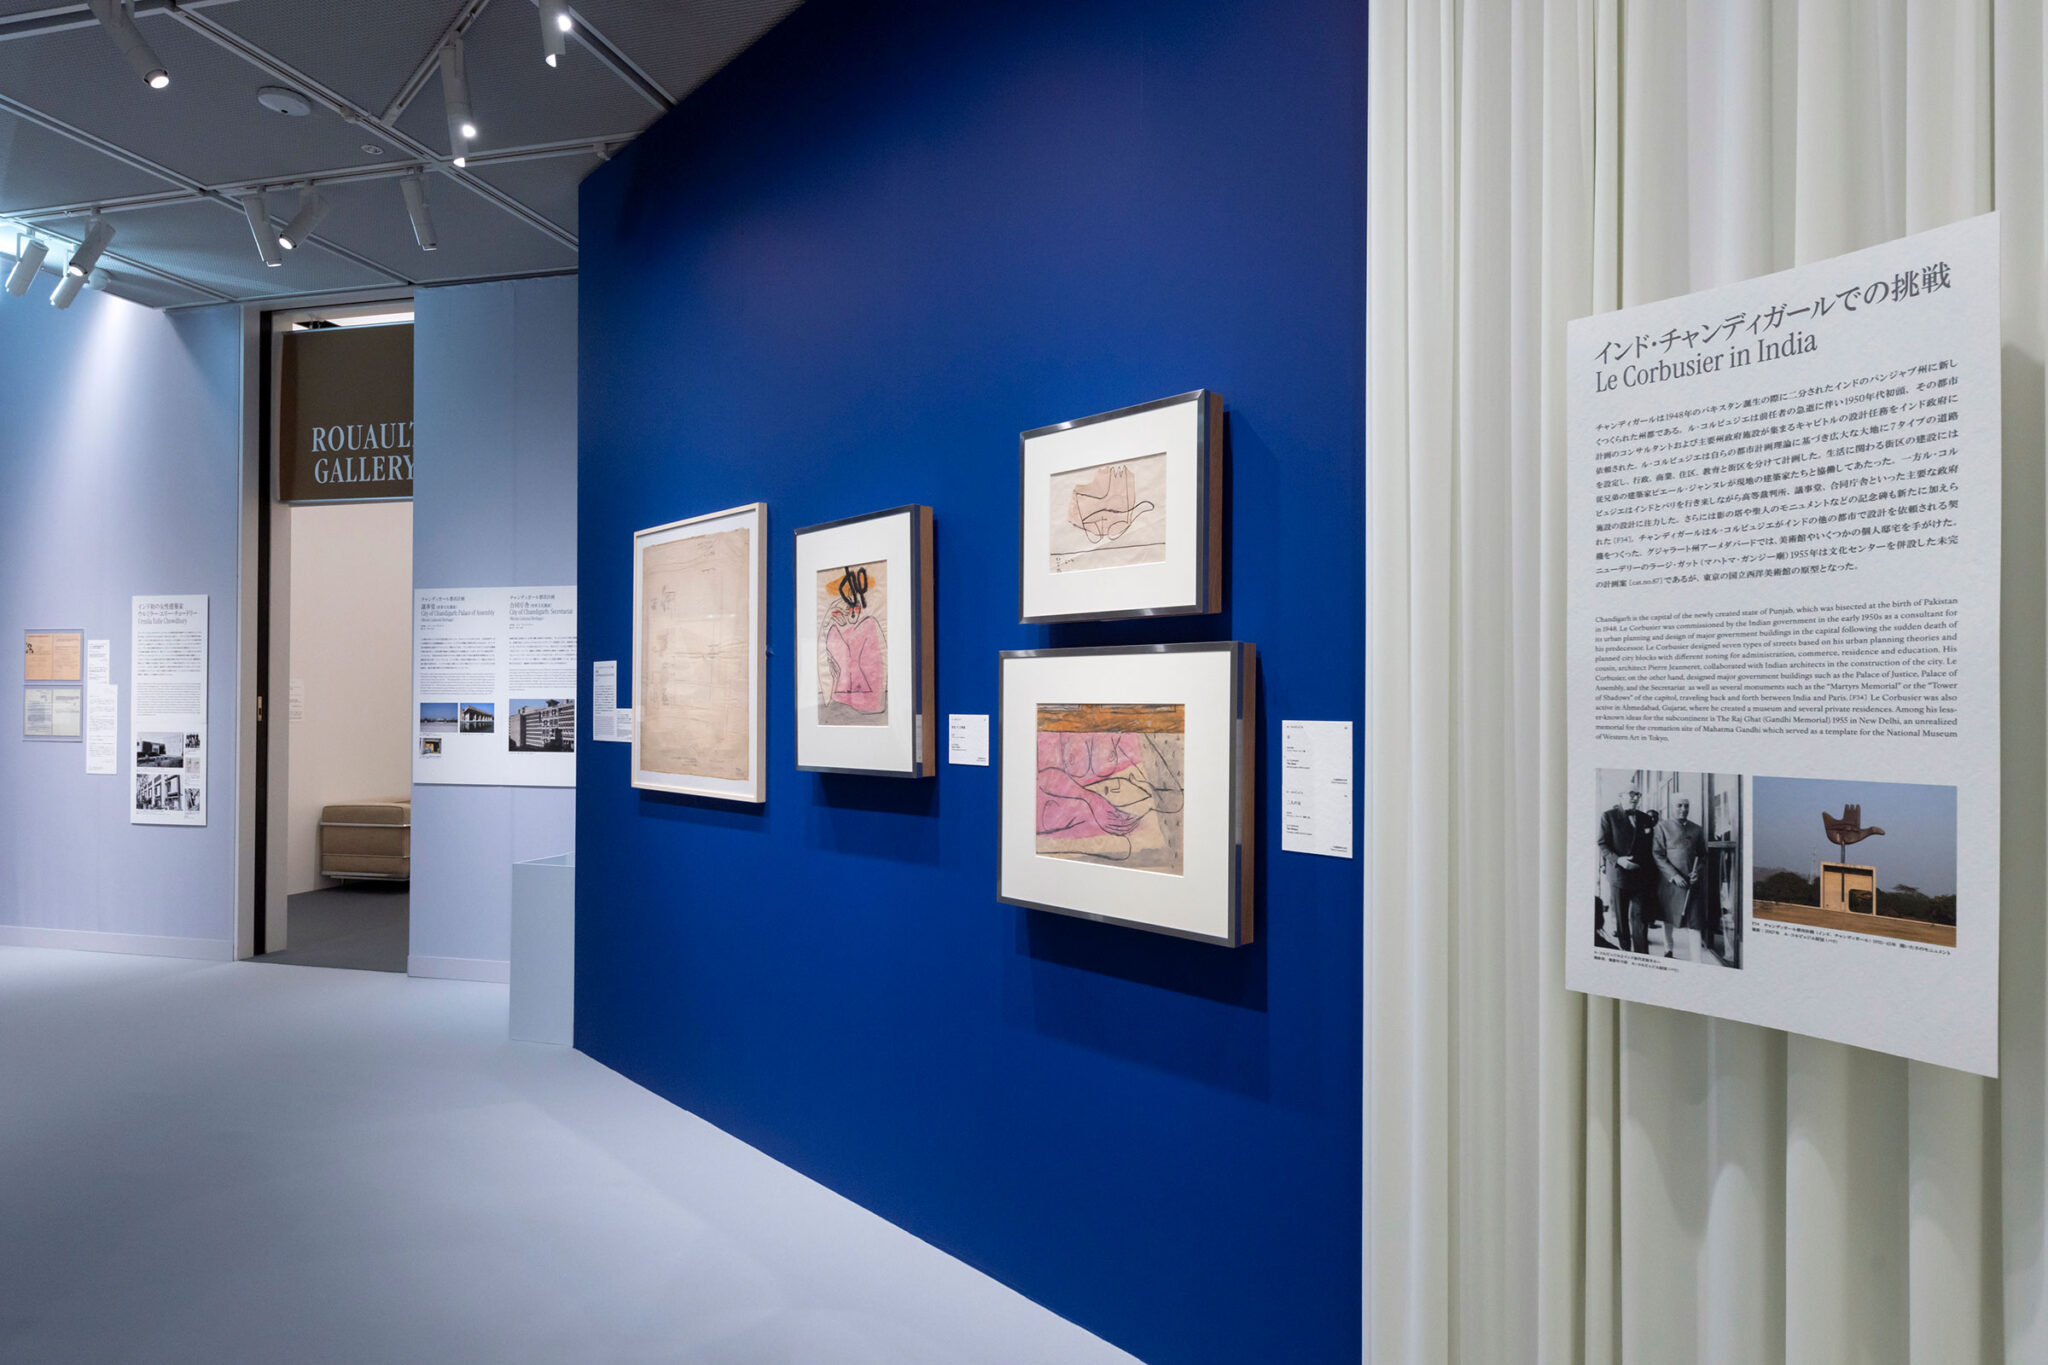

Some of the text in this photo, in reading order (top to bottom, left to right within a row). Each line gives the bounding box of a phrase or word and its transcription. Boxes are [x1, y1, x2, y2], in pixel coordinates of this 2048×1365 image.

[1594, 261, 1951, 363] インド・チャンディガールでの挑戦
[1596, 330, 1818, 392] Le Corbusier in India
[315, 455, 414, 484] GALLERY
[1650, 612, 1672, 622] capital
[1714, 608, 1740, 617] created
[1741, 607, 1758, 615] state
[1796, 604, 1818, 612] which
[1835, 601, 1867, 610] bisected
[1877, 600, 1890, 608] the
[1891, 599, 1911, 607] birth
[1923, 596, 1958, 606] Pakistan
[1628, 608, 1957, 631] Corbusier commissioned Indian government early 1950s consultant for
[1622, 621, 1946, 643] planning design government buildings capital following the sudden death
[1655, 642, 1688, 650] Corbusier
[1690, 641, 1720, 650] designed
[1742, 640, 1762, 649] types
[1772, 638, 1796, 646] streets
[1845, 636, 1868, 644] urban
[1869, 634, 1904, 645] planning
[1906, 633, 1940, 642] theories
[1941, 632, 1957, 641] and
[1594, 654, 1620, 663] planned
[1705, 651, 1728, 660] zoning
[1841, 647, 1879, 655] residence
[1880, 646, 1895, 654] and
[1942, 644, 1957, 653] His
[1703, 661, 1746, 669] collaborated
[1764, 660, 1788, 668] Indian
[1850, 658, 1900, 666] construction
[1912, 657, 1925, 665] the
[1686, 673, 1715, 681] designed
[1716, 672, 1736, 681] major
[1737, 672, 1779, 681] government
[1780, 671, 1812, 680] buildings
[1841, 670, 1854, 678] the
[1855, 670, 1880, 678] Palace
[1920, 669, 1946, 677] Palace
[1743, 682, 1785, 690] monuments
[1912, 681, 1926, 689] the
[1679, 693, 1708, 702] traveling
[1940, 693, 1957, 701] also
[1798, 704, 1823, 712] several
[1824, 704, 1850, 714] private
[1895, 705, 1924, 714] Among
[1925, 705, 1937, 713] his
[1762, 715, 1791, 724] (Gandhi
[1792, 715, 1831, 725] Memorial)
[1858, 716, 1877, 724] New
[1914, 716, 1957, 725] unrealized
[1602, 732, 1628, 740] Western
[1735, 725, 1761, 733] Gandhi
[1785, 726, 1809, 734] served
[1824, 727, 1858, 737] template
[1859, 727, 1870, 735] for
[1886, 728, 1920, 736] National
[1922, 728, 1958, 737] Museum
